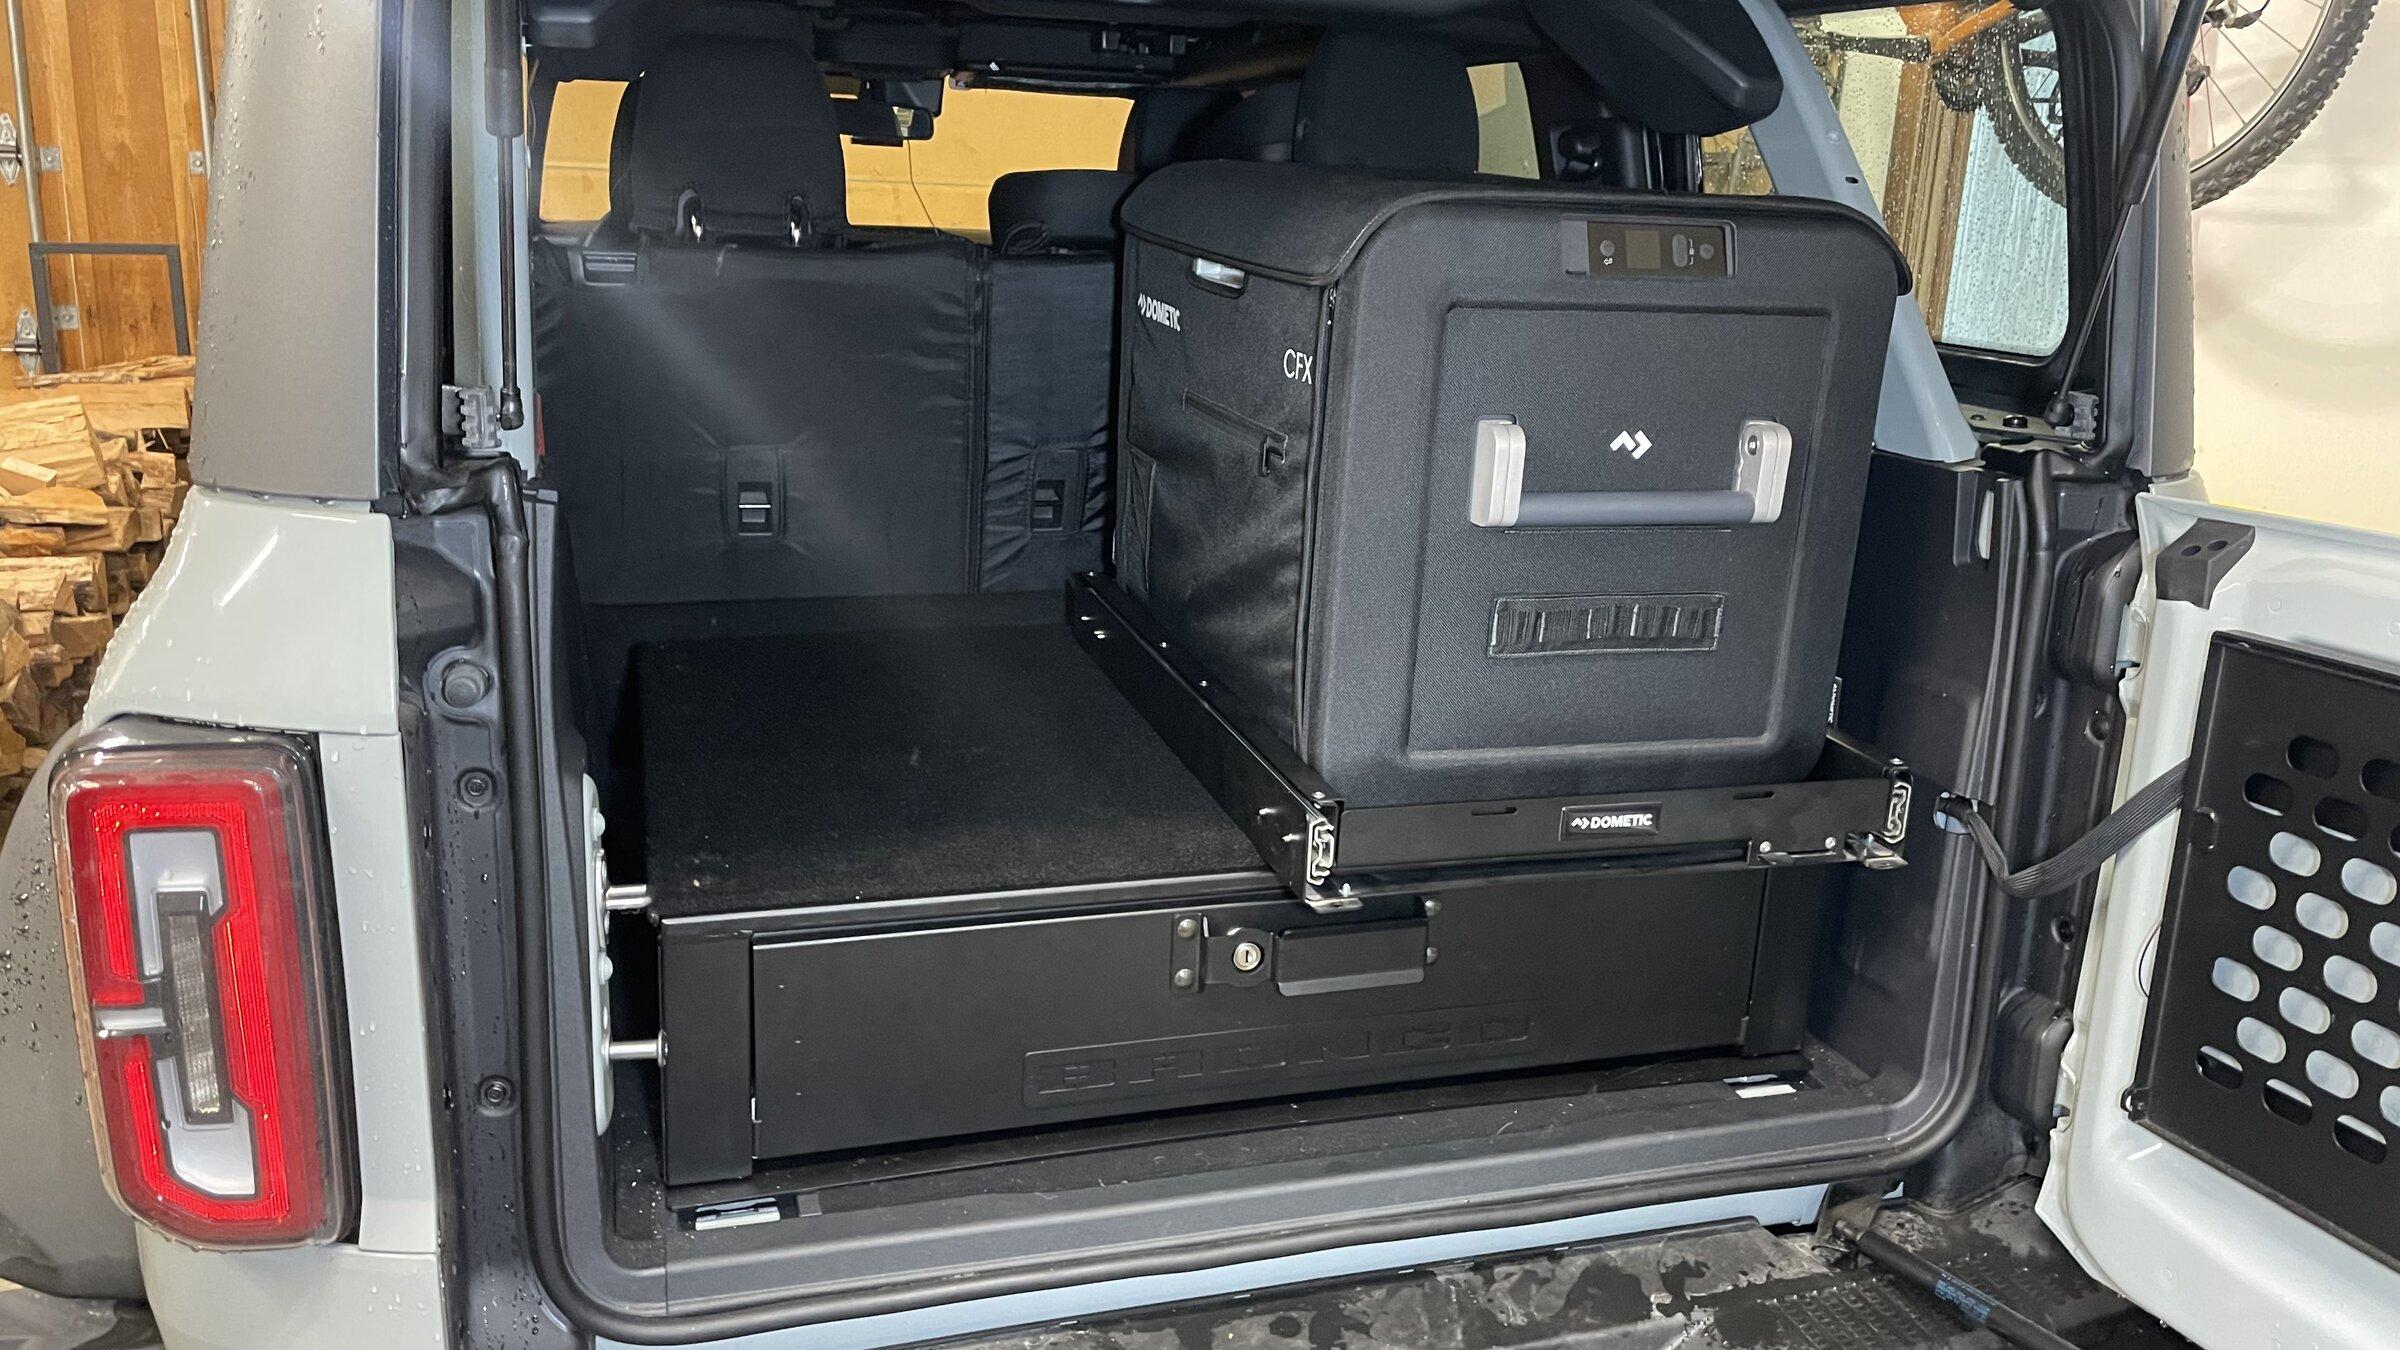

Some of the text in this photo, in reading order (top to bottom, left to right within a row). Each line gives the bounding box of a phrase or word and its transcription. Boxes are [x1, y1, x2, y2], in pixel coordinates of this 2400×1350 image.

[1146, 296, 1181, 331] DOMETIC
[1283, 348, 1313, 385] CFX
[1590, 813, 1653, 829] DOMETIC
[1035, 1013, 1533, 1095] BRONCO
